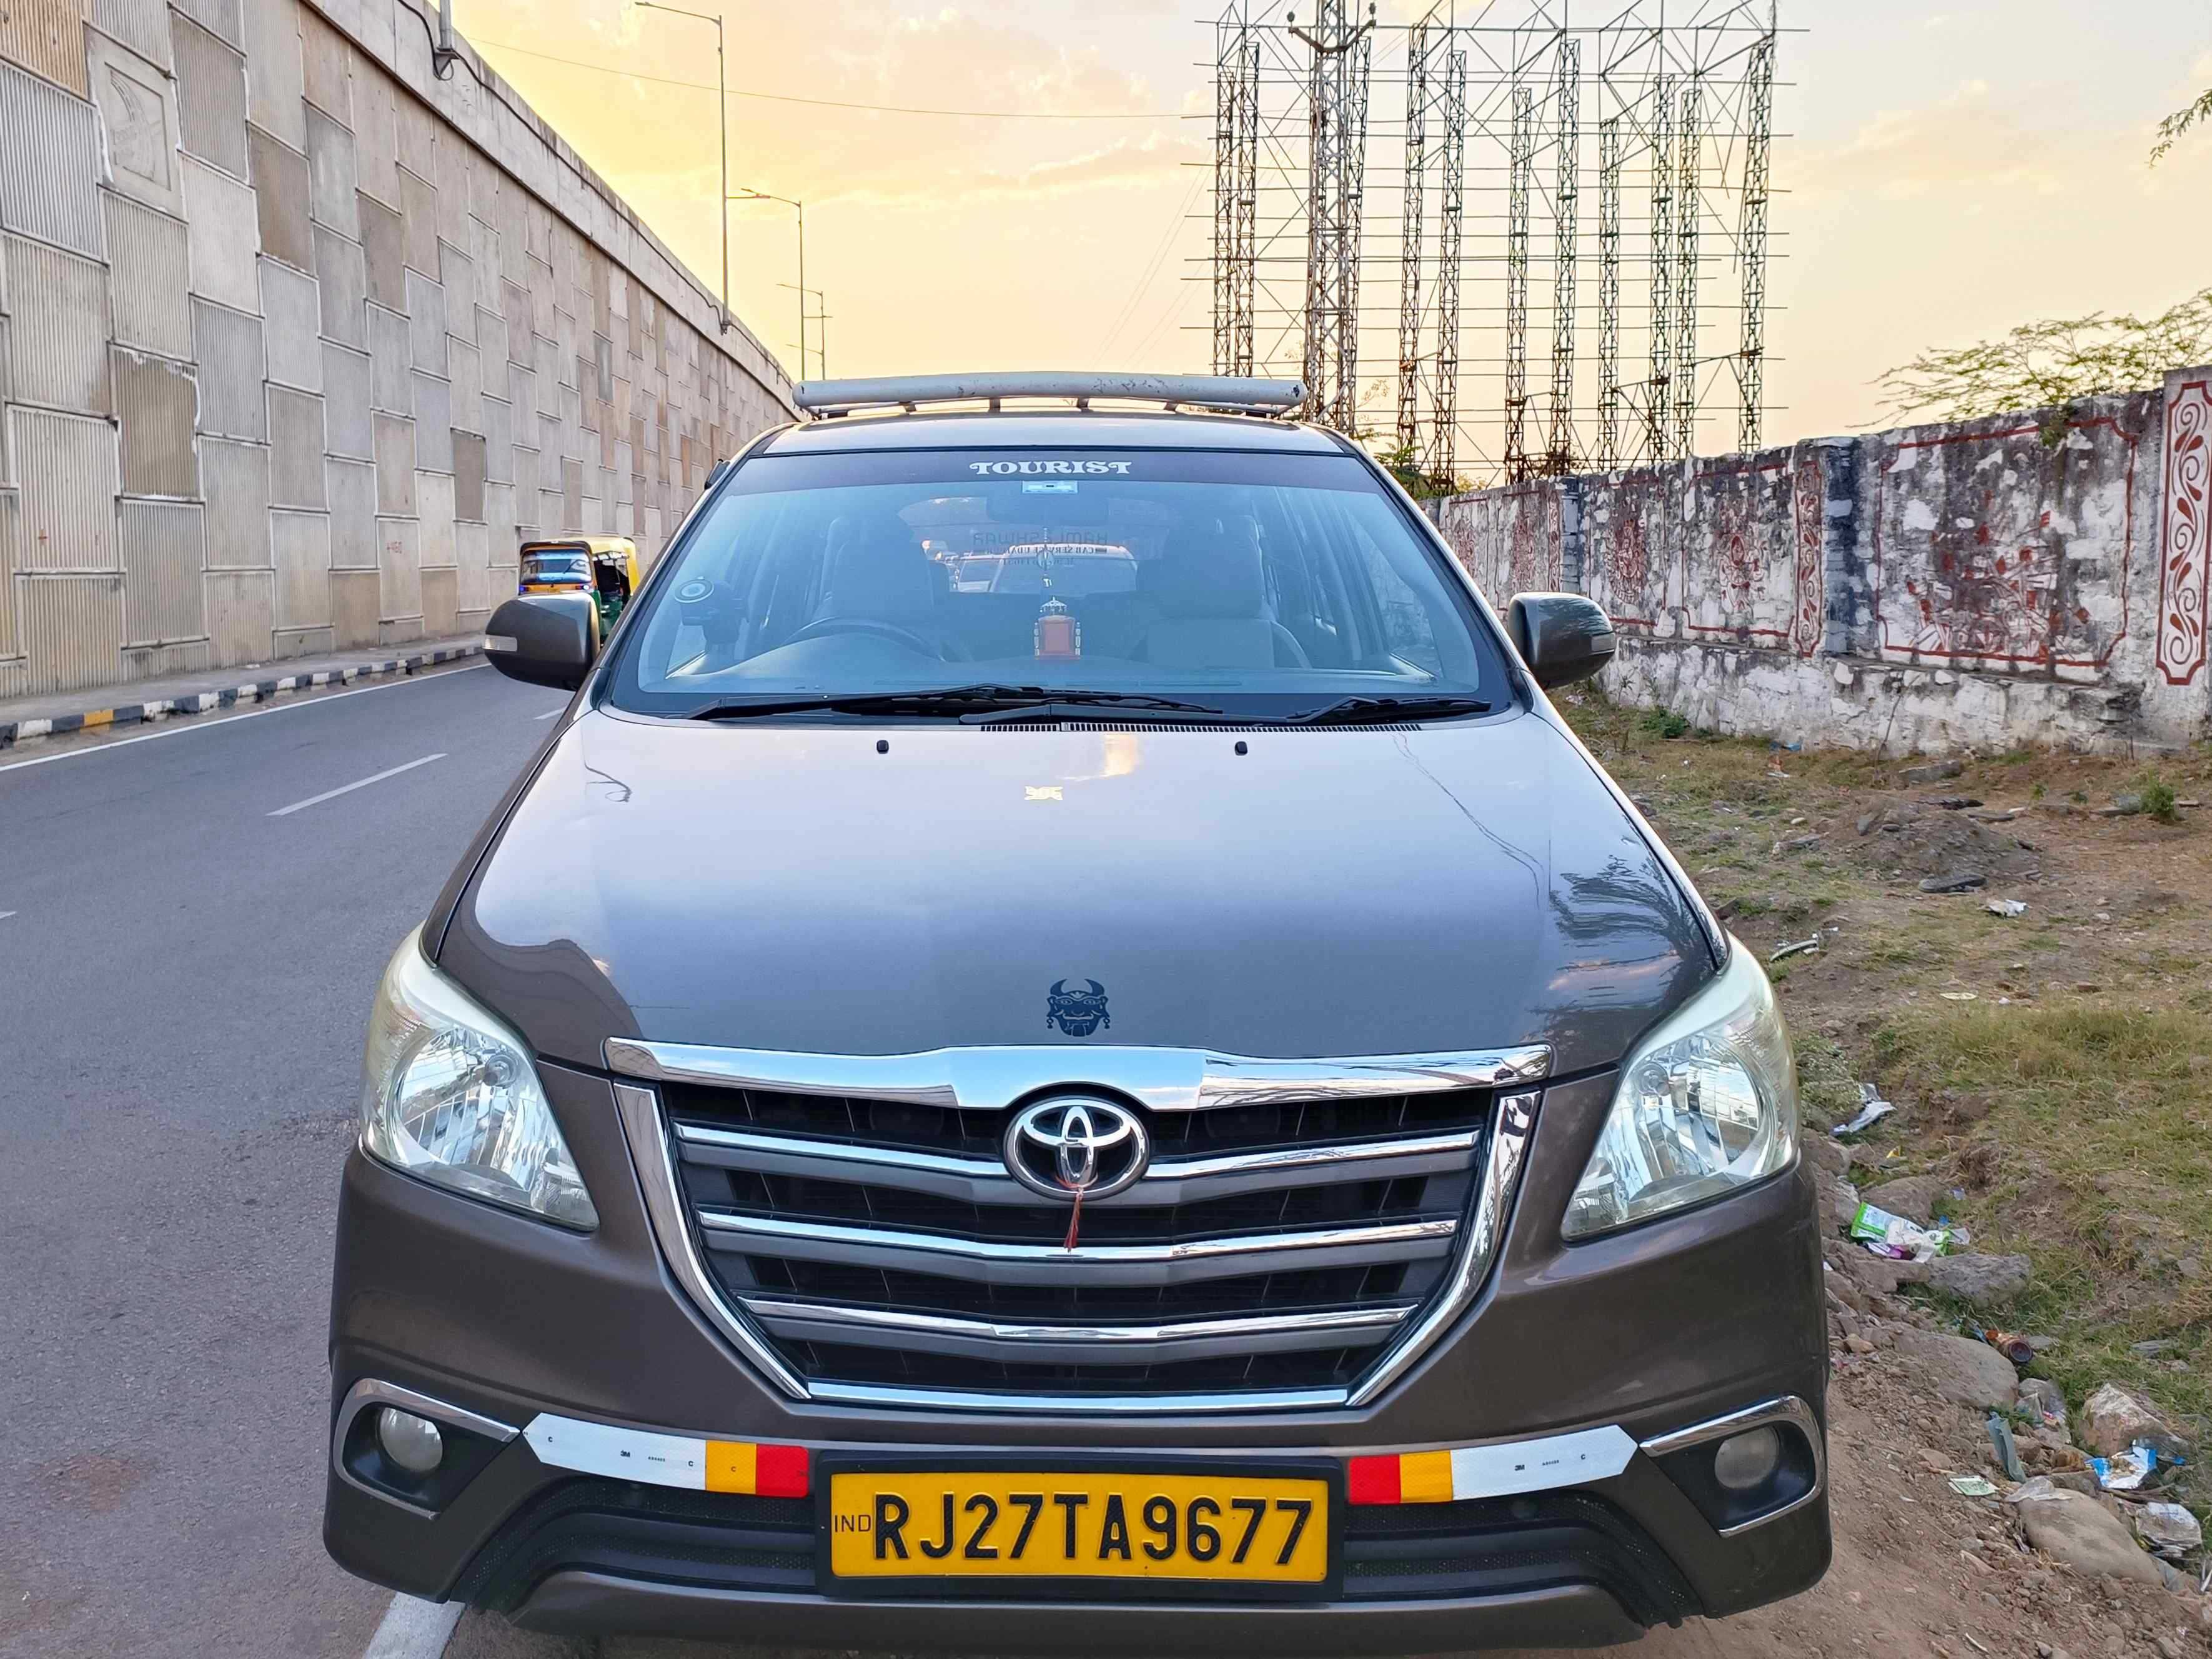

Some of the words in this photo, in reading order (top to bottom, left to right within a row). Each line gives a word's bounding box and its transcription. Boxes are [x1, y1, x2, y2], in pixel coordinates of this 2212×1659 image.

[970, 461, 1132, 474] TOURIST
[834, 1514, 871, 1533] IND
[875, 1492, 1312, 1565] RJ27TA9677
